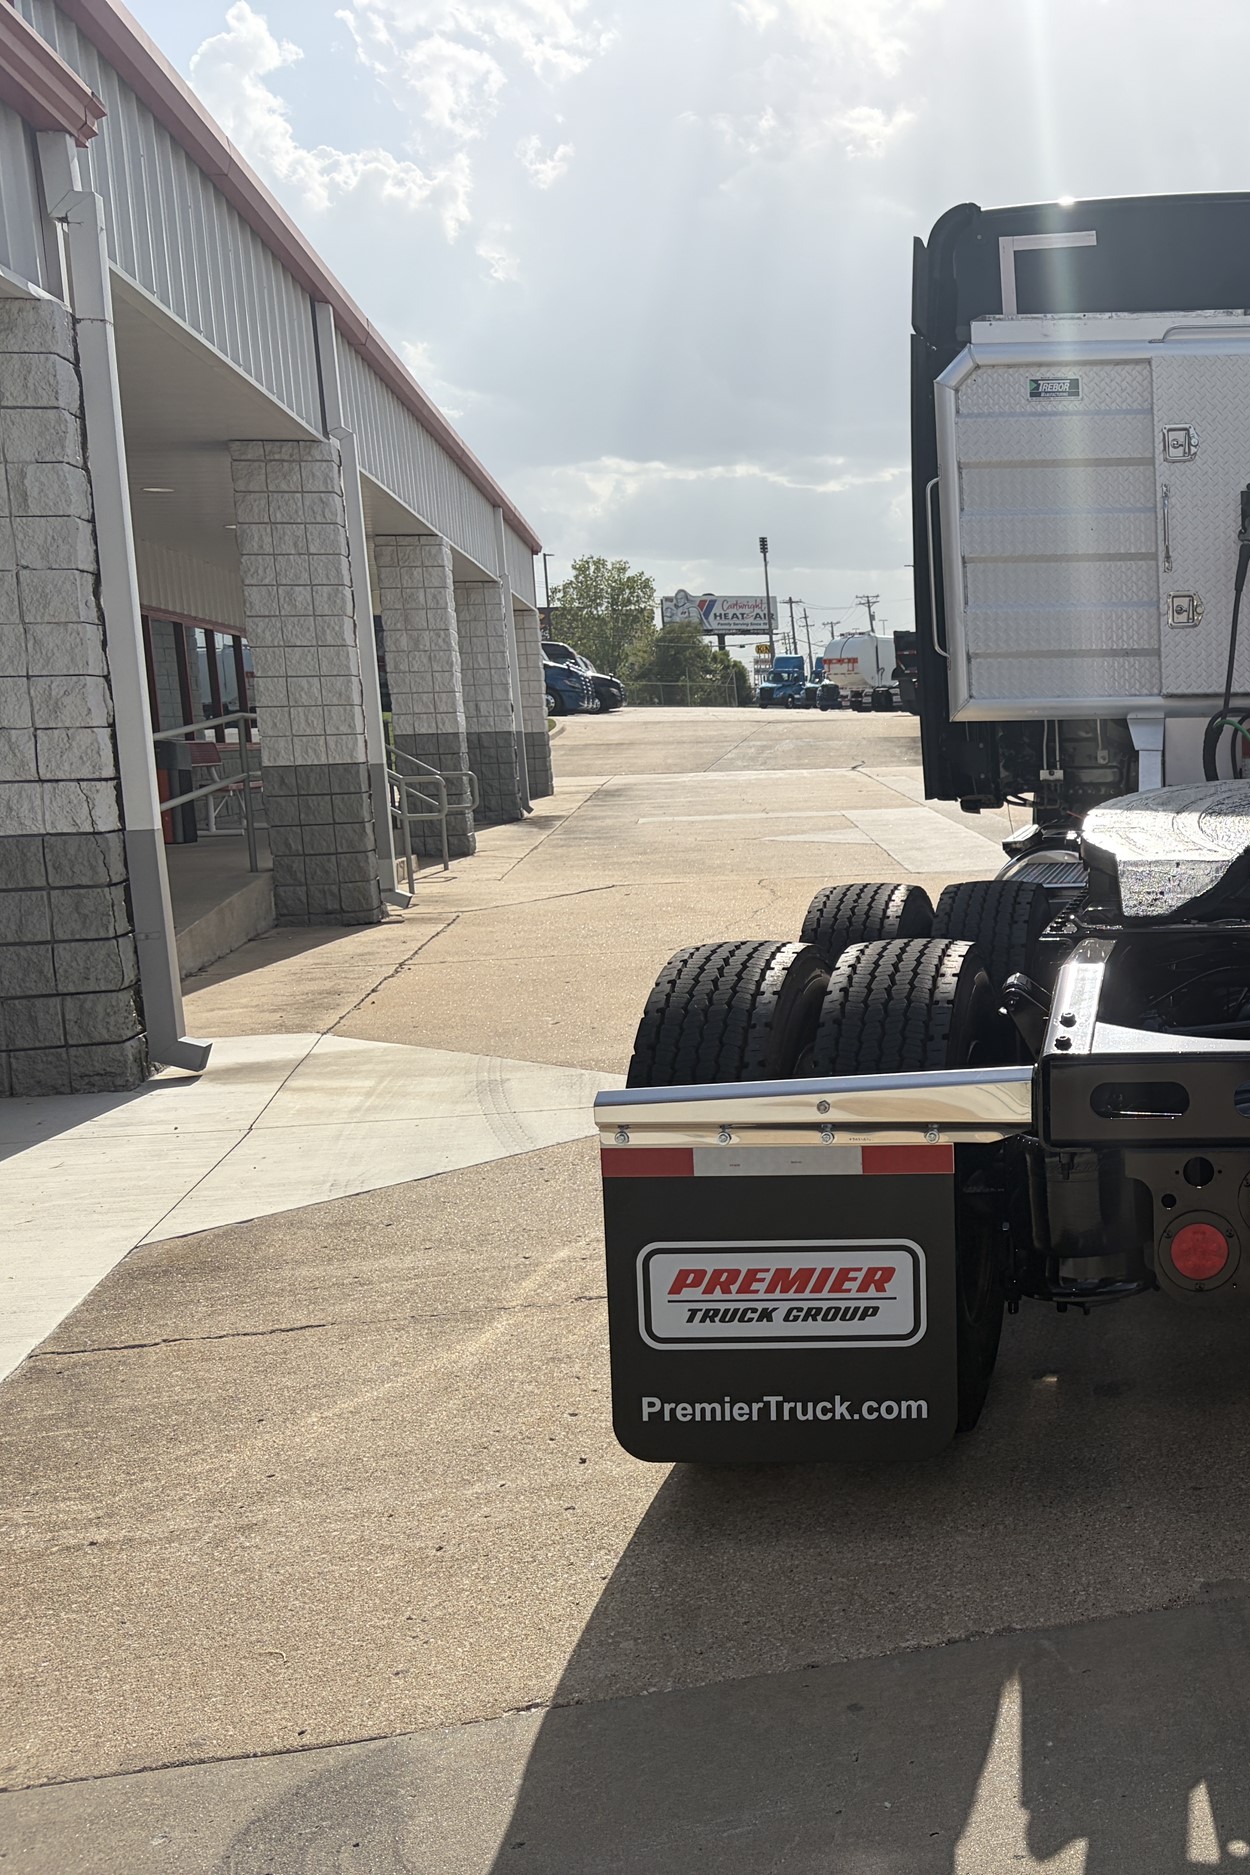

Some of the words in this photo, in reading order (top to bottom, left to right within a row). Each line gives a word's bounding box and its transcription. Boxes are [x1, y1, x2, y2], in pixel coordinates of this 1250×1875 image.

[1038, 380, 1070, 391] TREBOR
[713, 612, 746, 620] HEAT
[667, 1266, 896, 1295] PREMIER
[685, 1307, 779, 1324] TRUCK
[782, 1305, 880, 1323] GROUP
[641, 1395, 928, 1421] PremierTruck.com
